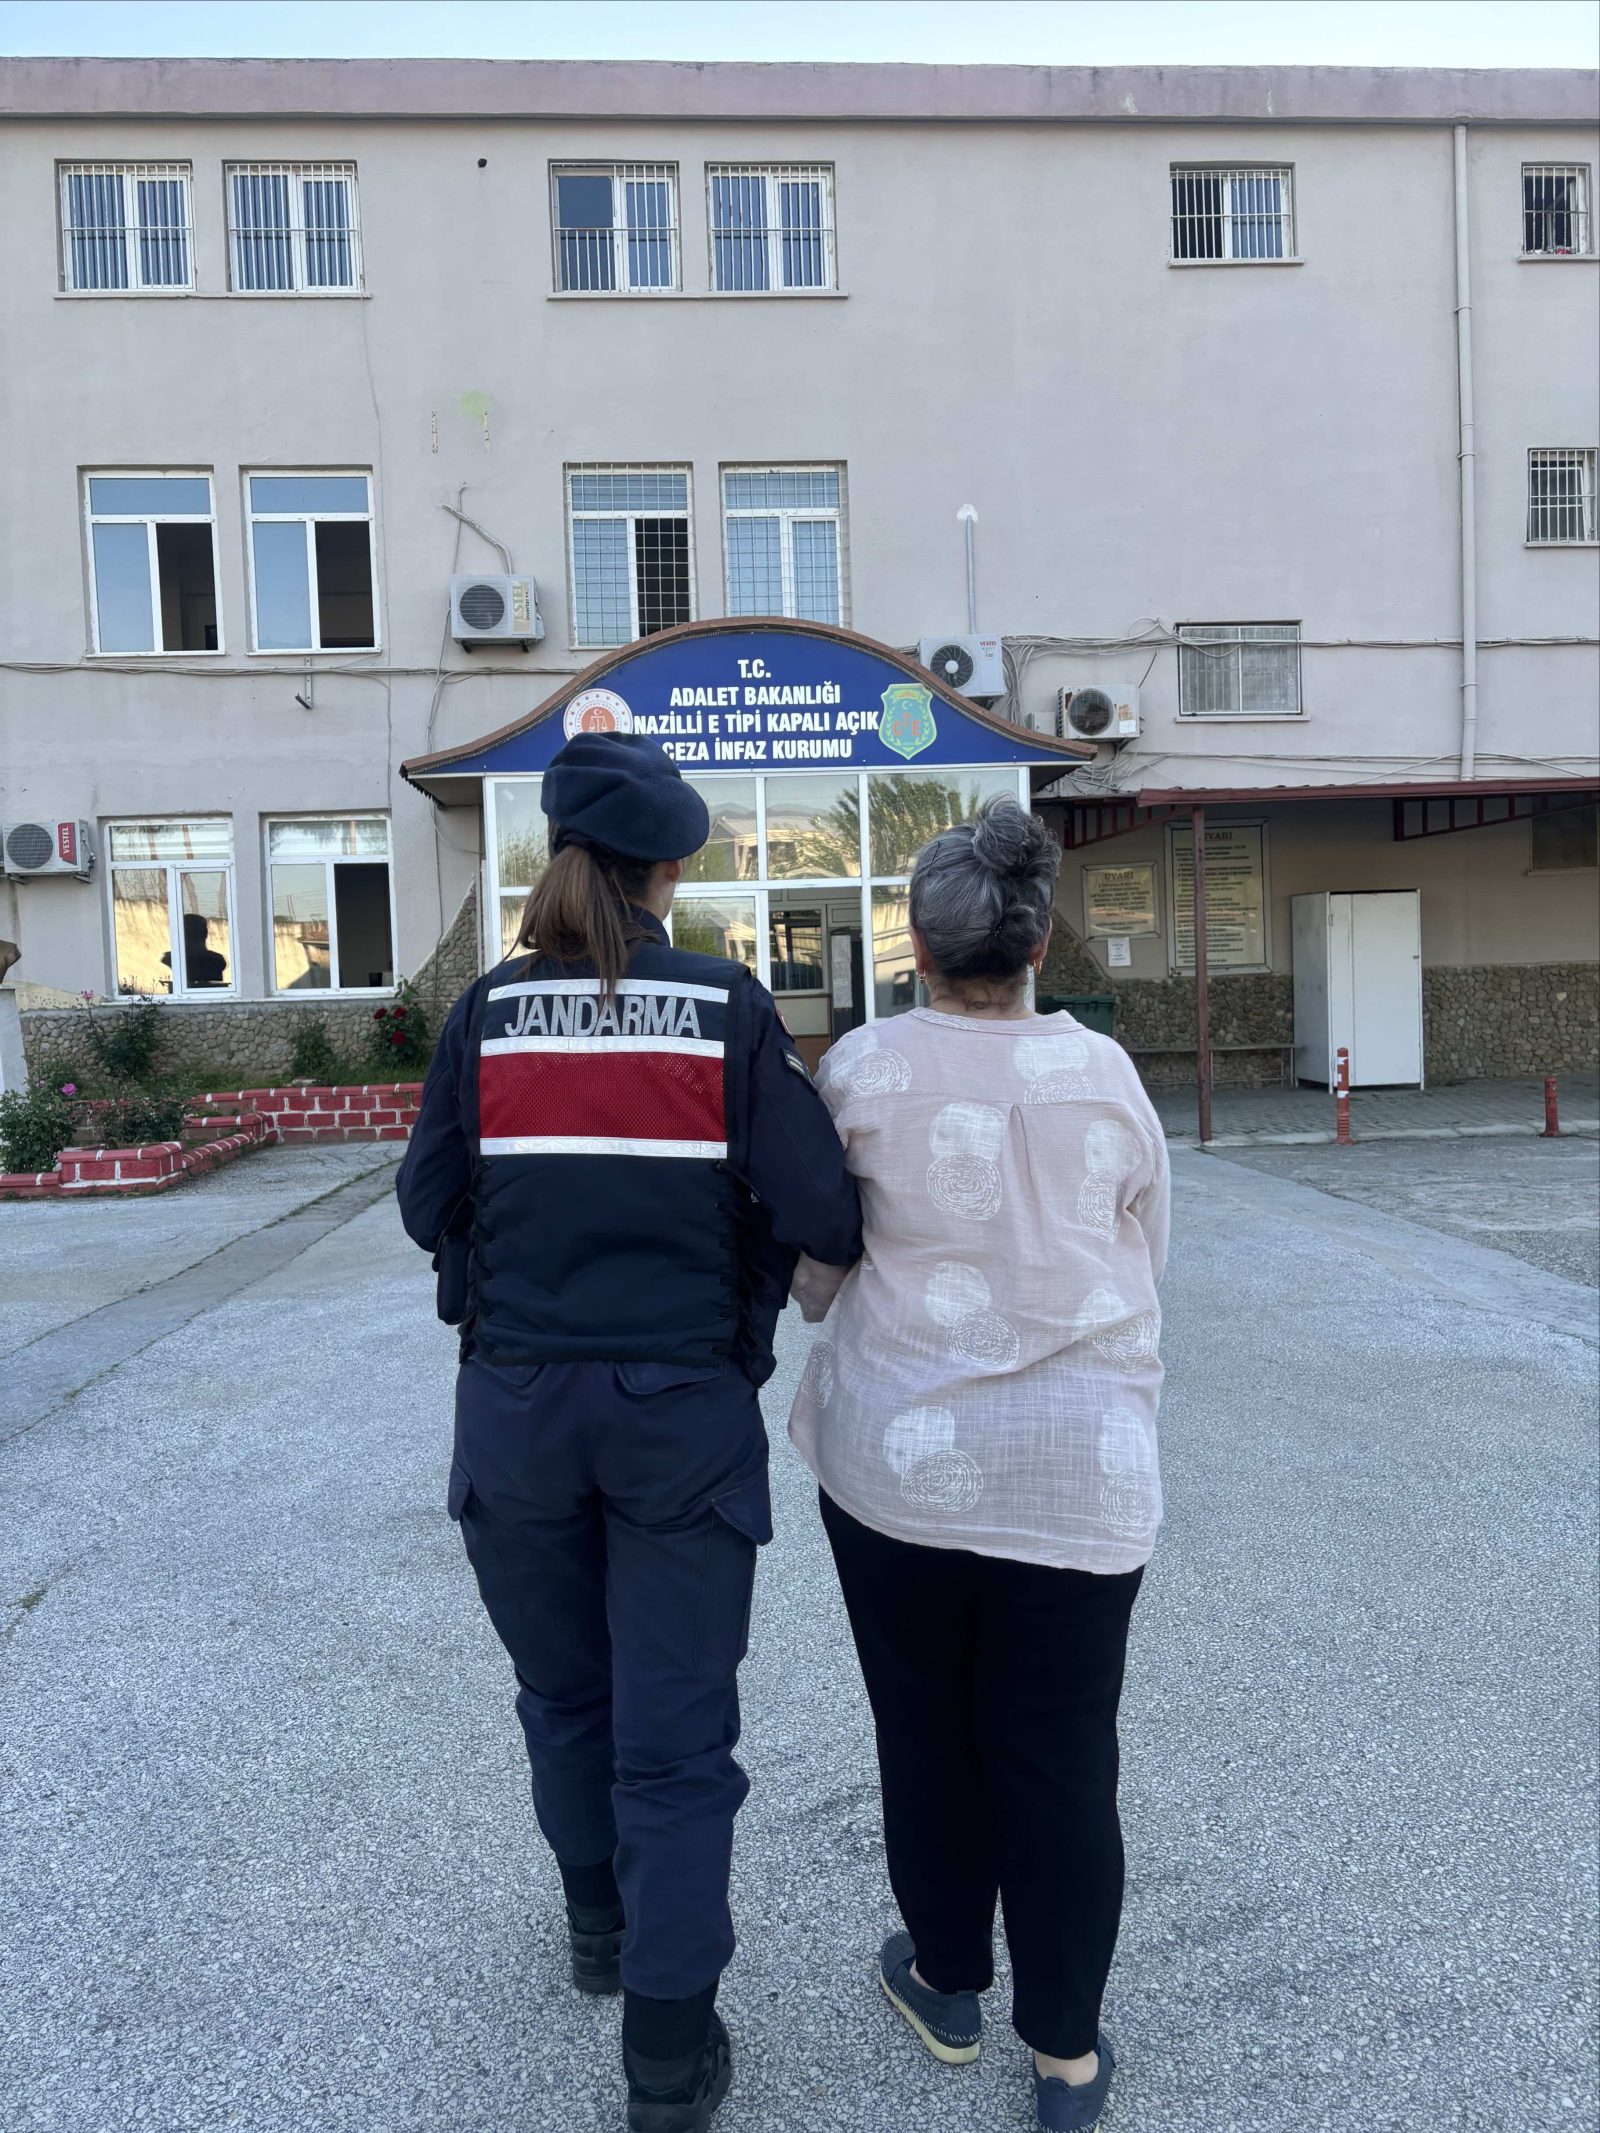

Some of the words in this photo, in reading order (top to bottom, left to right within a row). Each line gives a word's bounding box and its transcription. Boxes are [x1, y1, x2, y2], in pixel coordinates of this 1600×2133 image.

[737, 659, 771, 678] T.C.
[670, 687, 739, 707] ADALET
[744, 681, 840, 706] BAKANLIĞI
[634, 710, 702, 734] NAZİLLİ
[708, 714, 719, 734] E
[725, 709, 761, 733] TİPİ
[767, 712, 830, 732] KAPALI
[835, 711, 879, 736] AÇIK
[662, 741, 709, 761] CEZA
[715, 737, 767, 761] İNFAZ
[773, 739, 852, 759] KURUMU
[62, 826, 70, 854] VESTEL
[1104, 871, 1134, 880] UYARI
[505, 995, 702, 1038] JANDARMA
